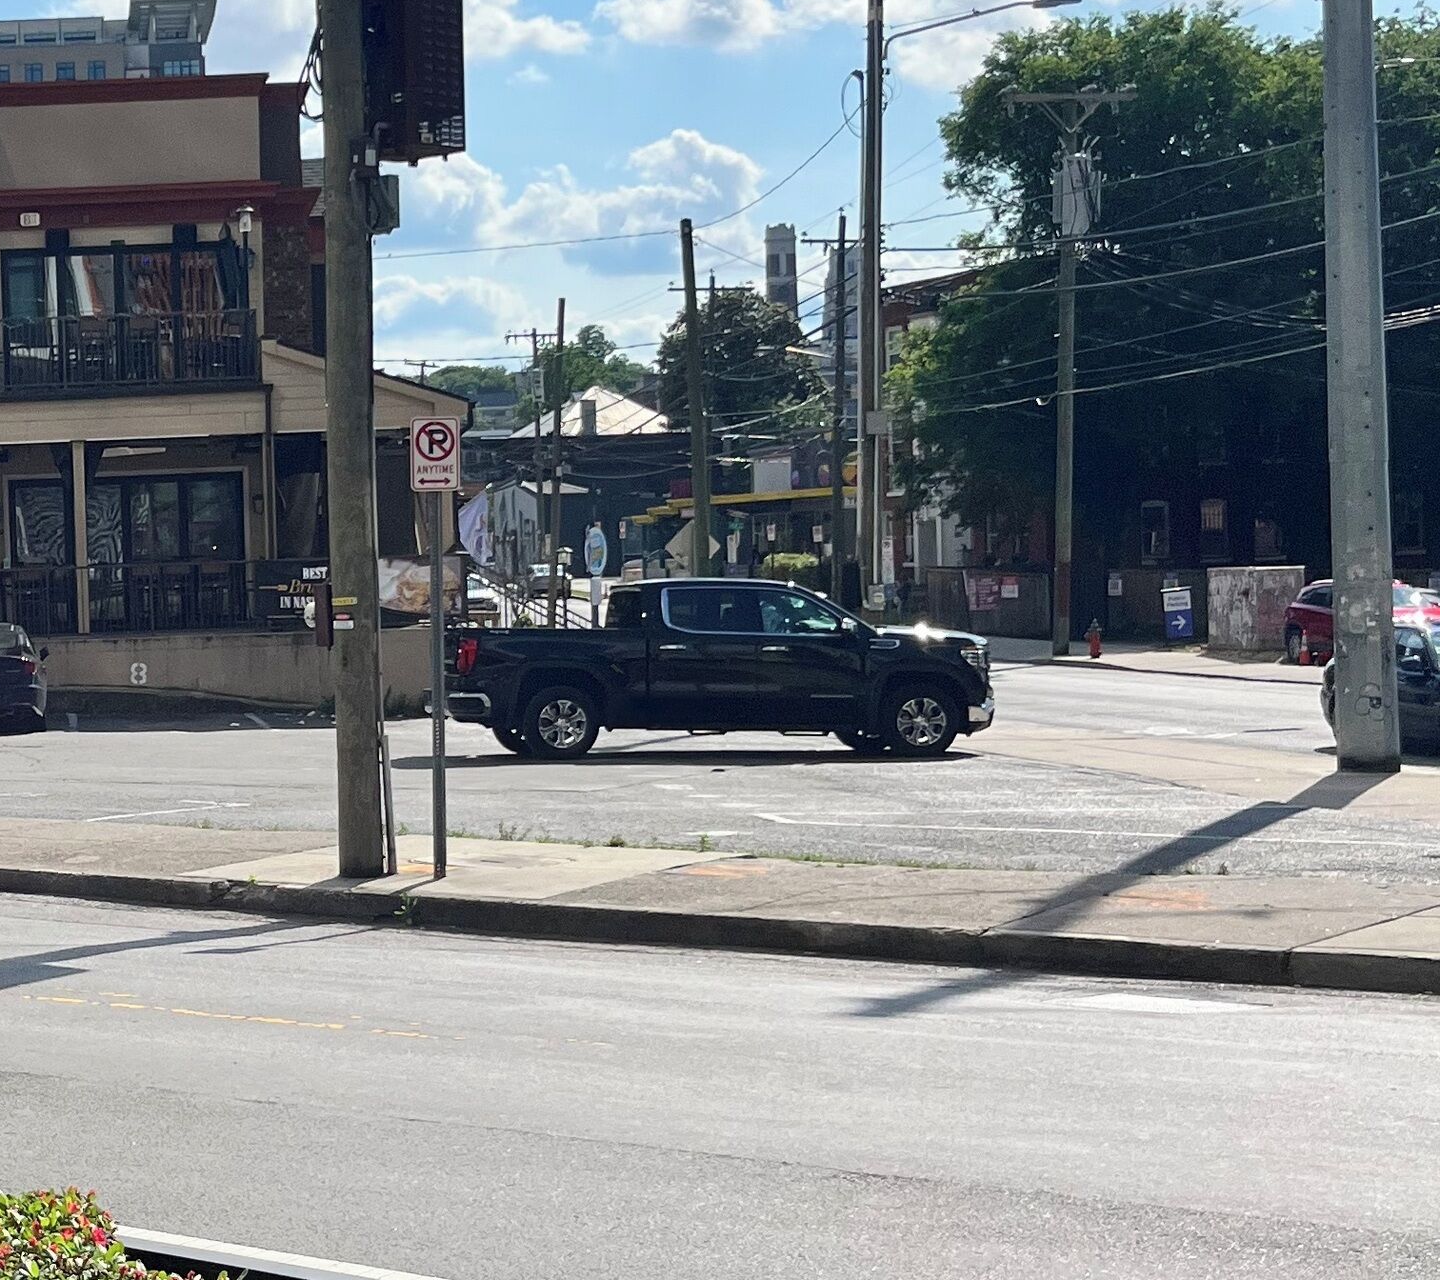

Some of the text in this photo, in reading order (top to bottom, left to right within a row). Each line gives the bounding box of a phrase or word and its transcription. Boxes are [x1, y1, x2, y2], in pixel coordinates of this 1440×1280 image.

[417, 465, 454, 474] ANYTIME
[302, 566, 328, 579] BEST
[280, 596, 315, 609] IN NAS
[131, 662, 147, 685] 8
